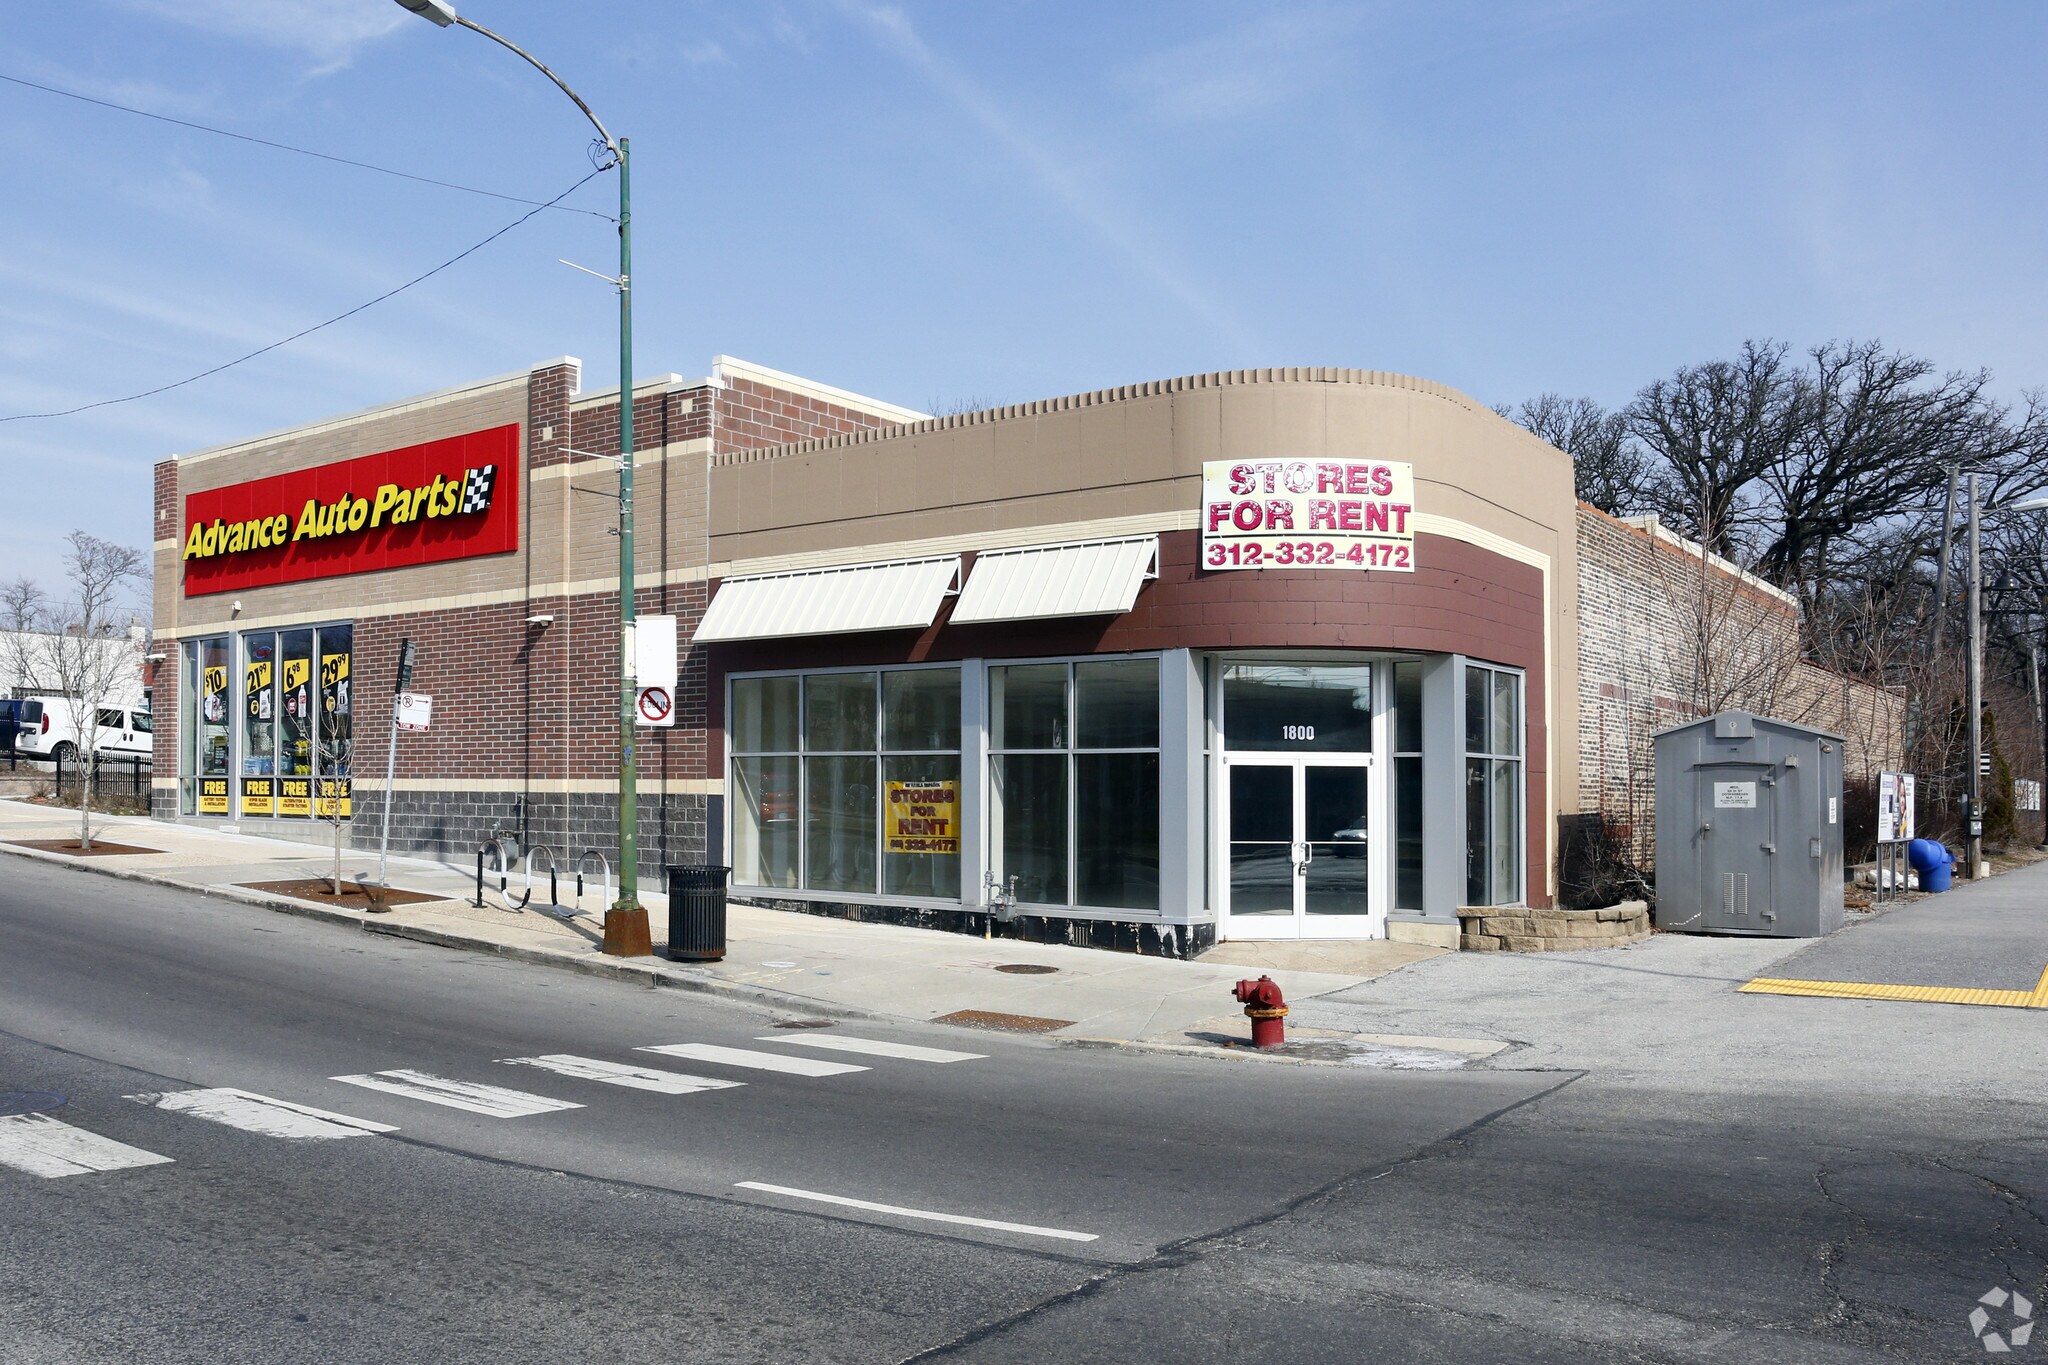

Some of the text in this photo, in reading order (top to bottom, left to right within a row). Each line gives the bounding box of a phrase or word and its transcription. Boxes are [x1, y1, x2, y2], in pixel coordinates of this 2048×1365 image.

[1228, 462, 1393, 496] STORES
[182, 473, 460, 561] Advance Auto Parts
[1208, 499, 1412, 533] FOR RENT
[1207, 541, 1411, 568] 312-332-4172
[205, 669, 222, 693] $10
[1282, 725, 1315, 741] 1800
[204, 780, 226, 795] FREE
[246, 780, 270, 795] FREE
[283, 781, 307, 796] FREE
[322, 782, 347, 796] FRE
[890, 789, 955, 803] STORES
[910, 805, 936, 817] FOR
[898, 818, 948, 835] RENT
